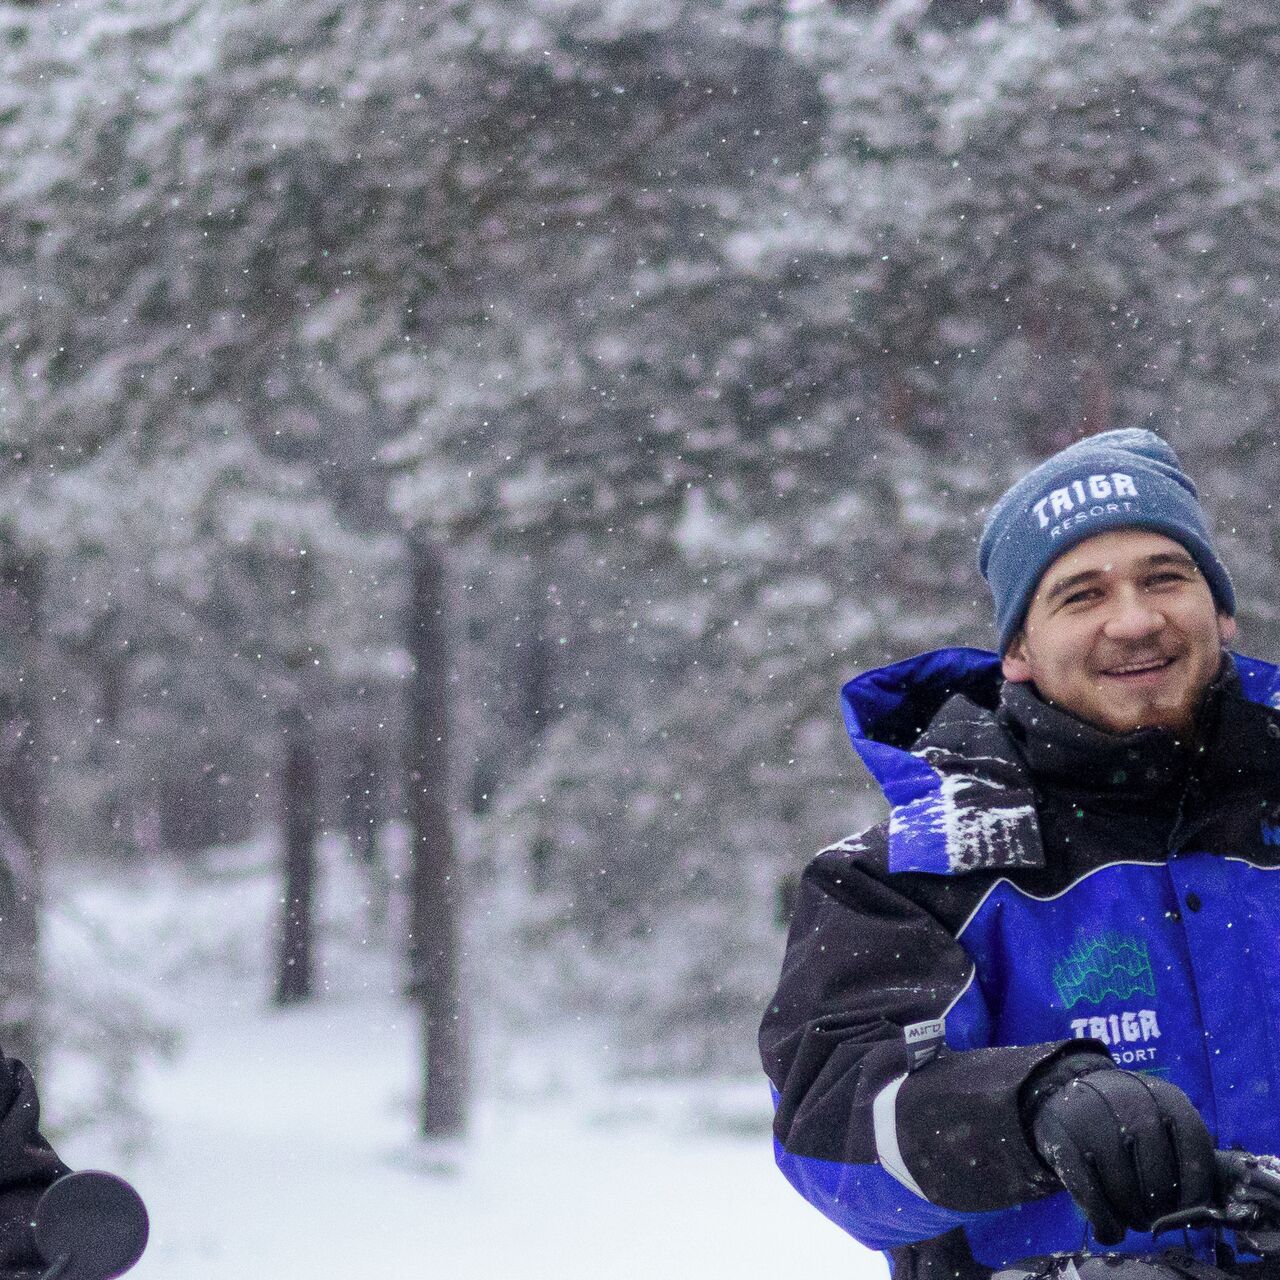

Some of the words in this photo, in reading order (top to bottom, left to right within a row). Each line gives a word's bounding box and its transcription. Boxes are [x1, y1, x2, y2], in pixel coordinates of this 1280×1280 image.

[1032, 472, 1138, 528] TAIGA
[1050, 502, 1131, 538] RESORT
[1071, 1010, 1161, 1045] TAIGA
[1111, 1048, 1157, 1064] SORT
